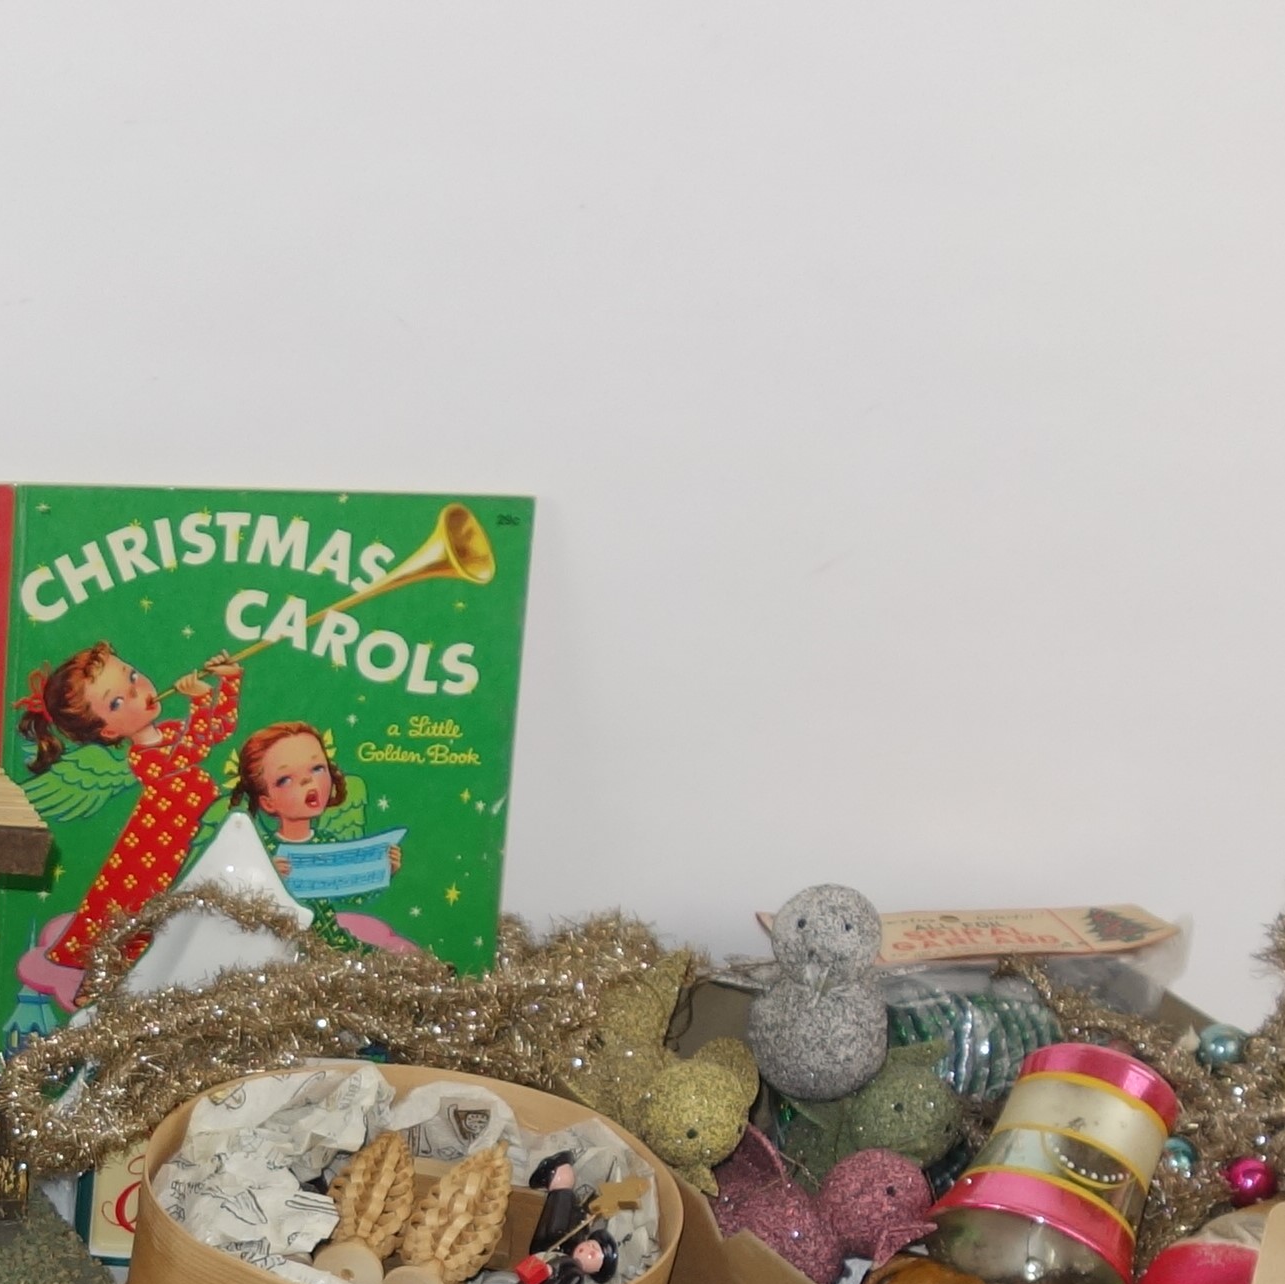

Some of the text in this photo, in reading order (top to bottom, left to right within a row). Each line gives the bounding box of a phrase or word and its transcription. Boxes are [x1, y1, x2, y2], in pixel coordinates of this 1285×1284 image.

[19, 511, 397, 623] CHRISTMAS
[224, 589, 480, 696] CAROLS
[387, 715, 463, 738] a Little
[358, 742, 482, 765] Golden Book
[892, 933, 1061, 951] GARLAND
[903, 925, 1026, 940] SPIRAL
